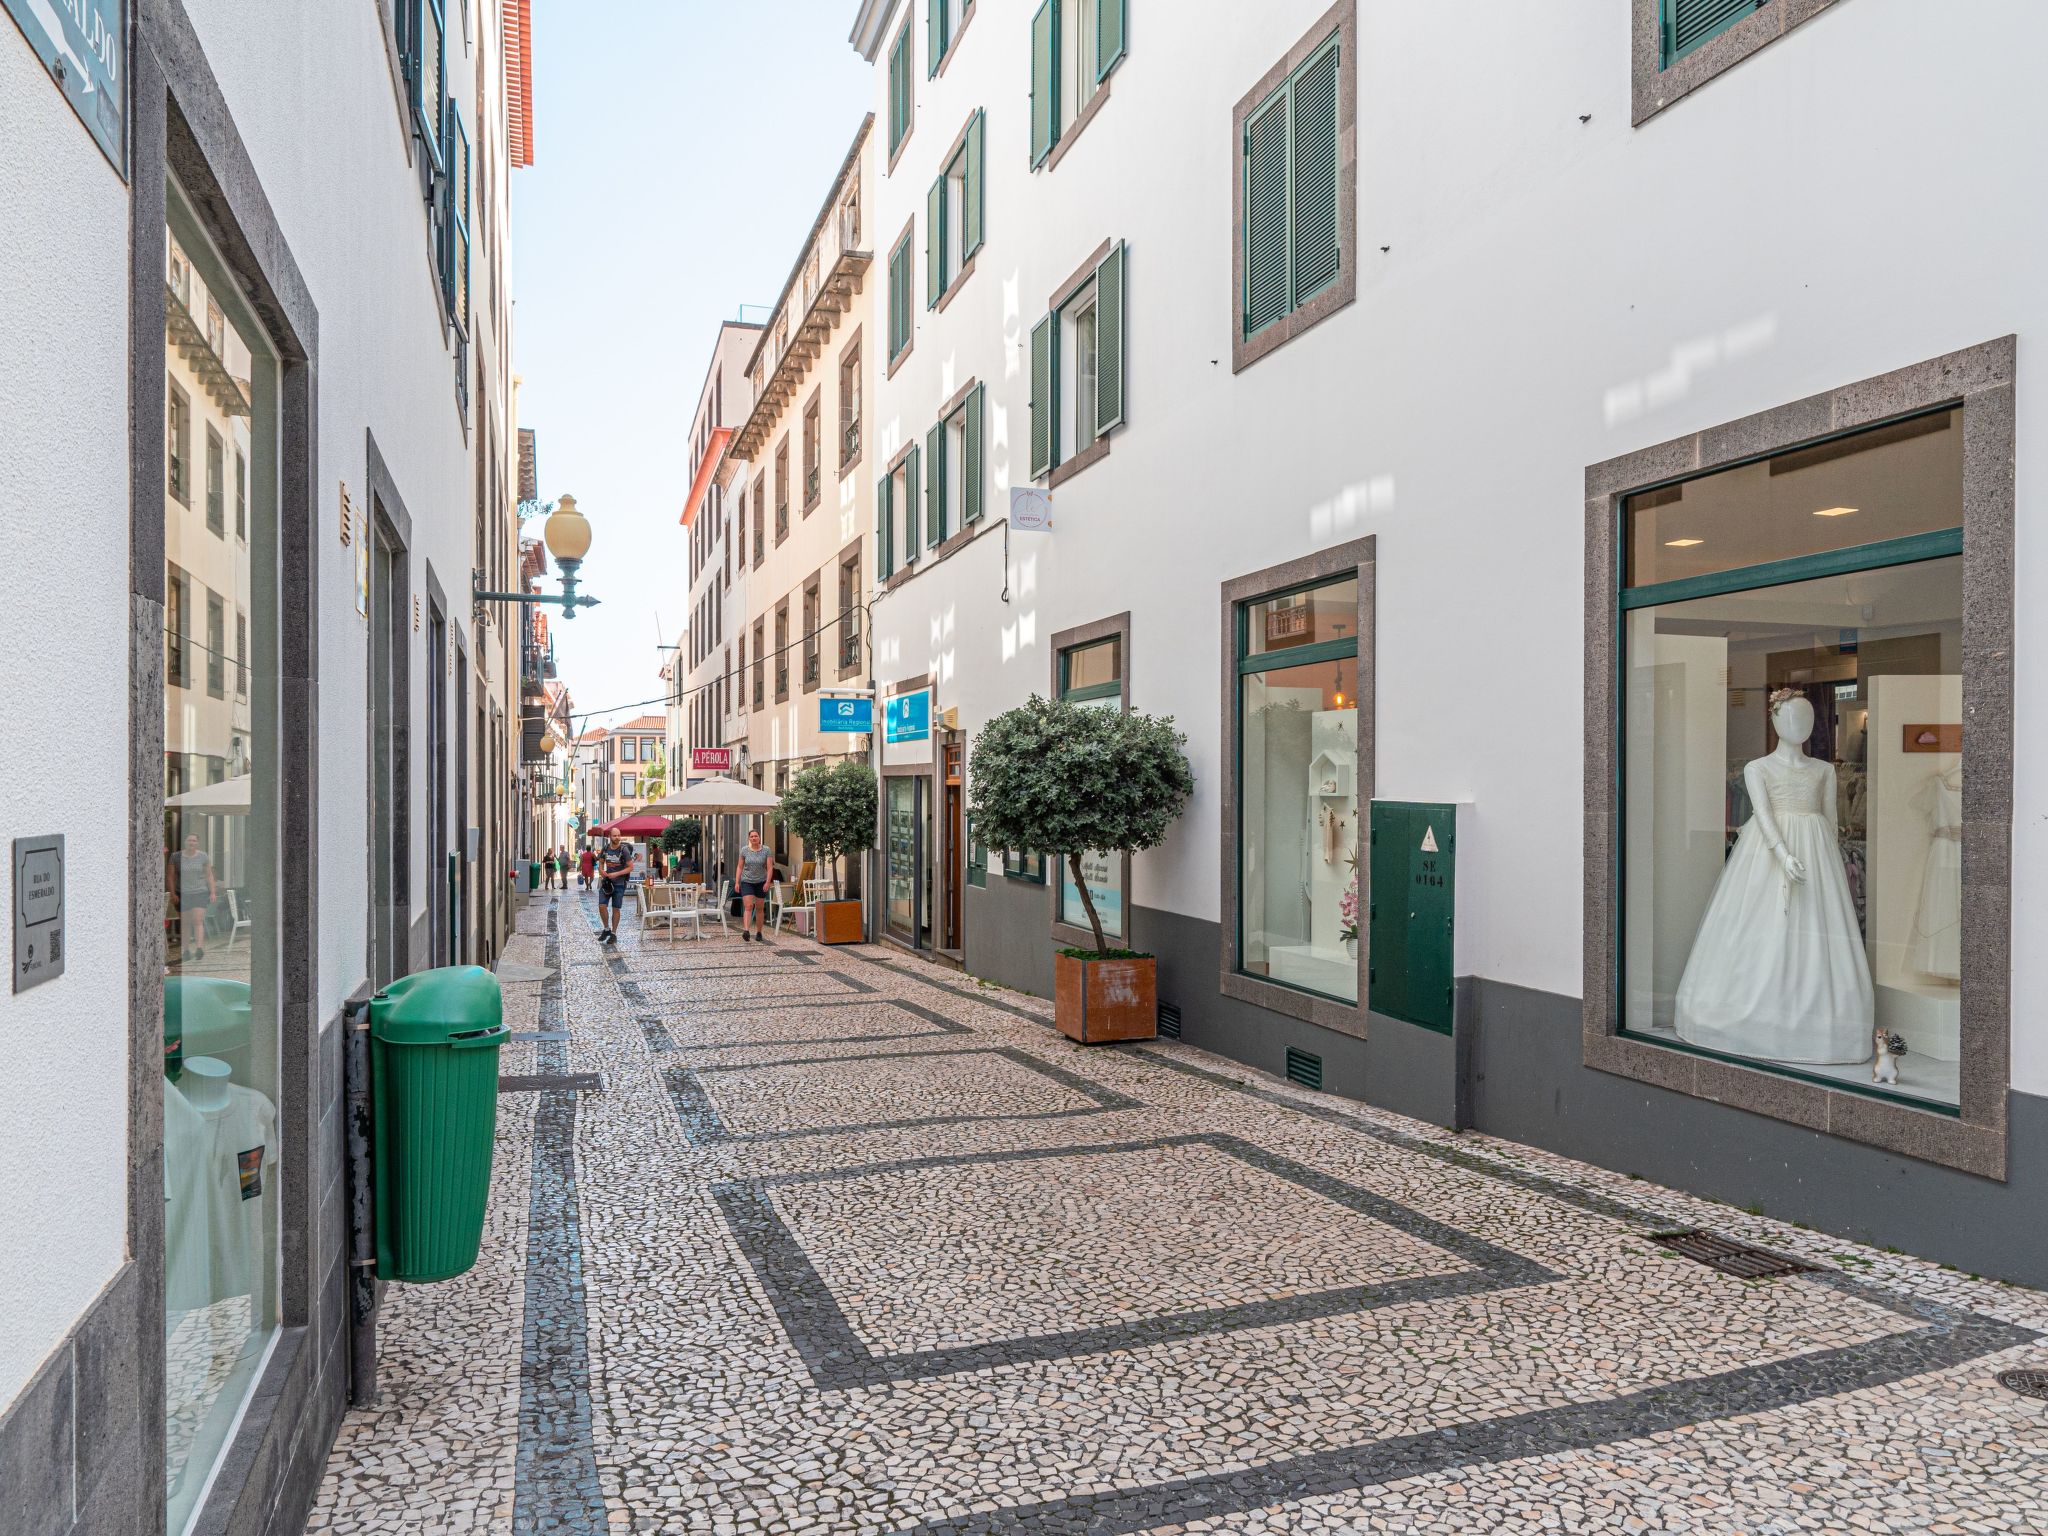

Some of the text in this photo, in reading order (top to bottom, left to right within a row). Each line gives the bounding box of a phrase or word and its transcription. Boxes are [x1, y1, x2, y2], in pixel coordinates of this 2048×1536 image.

[695, 750, 728, 764] A PÉROLA
[1423, 861, 1436, 872] SE
[33, 871, 50, 884] RUA DO
[1416, 874, 1443, 887] 0164
[29, 886, 54, 900] ESMERALDO
